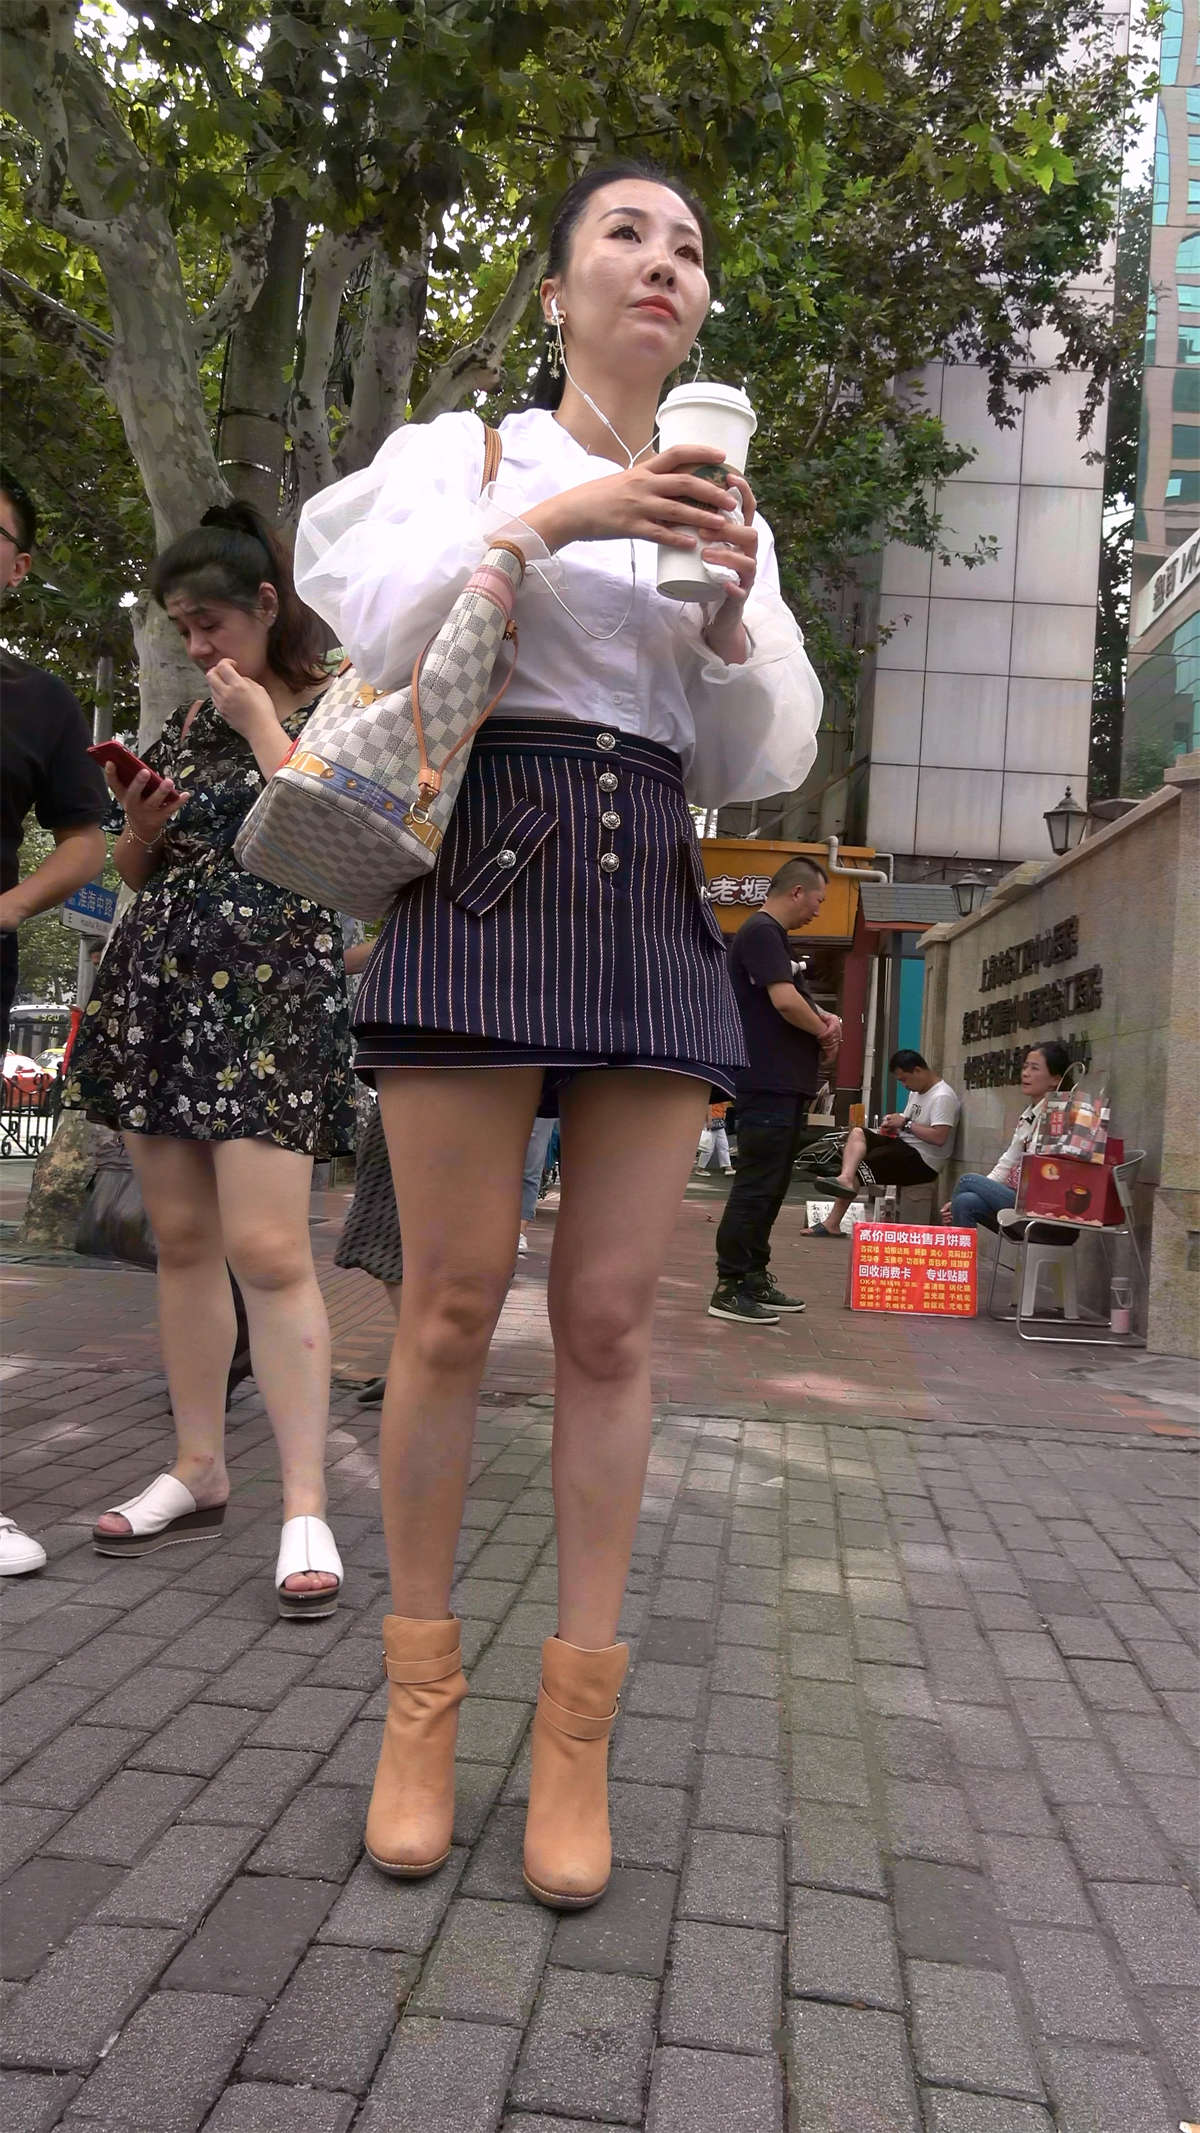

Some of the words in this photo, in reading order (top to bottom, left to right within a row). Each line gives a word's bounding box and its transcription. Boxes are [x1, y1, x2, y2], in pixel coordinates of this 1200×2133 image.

[859, 1229, 972, 1248] 高价回收出售月饼票
[858, 1265, 912, 1280] 回收消费卡
[926, 1268, 968, 1283] 专业贴膜
